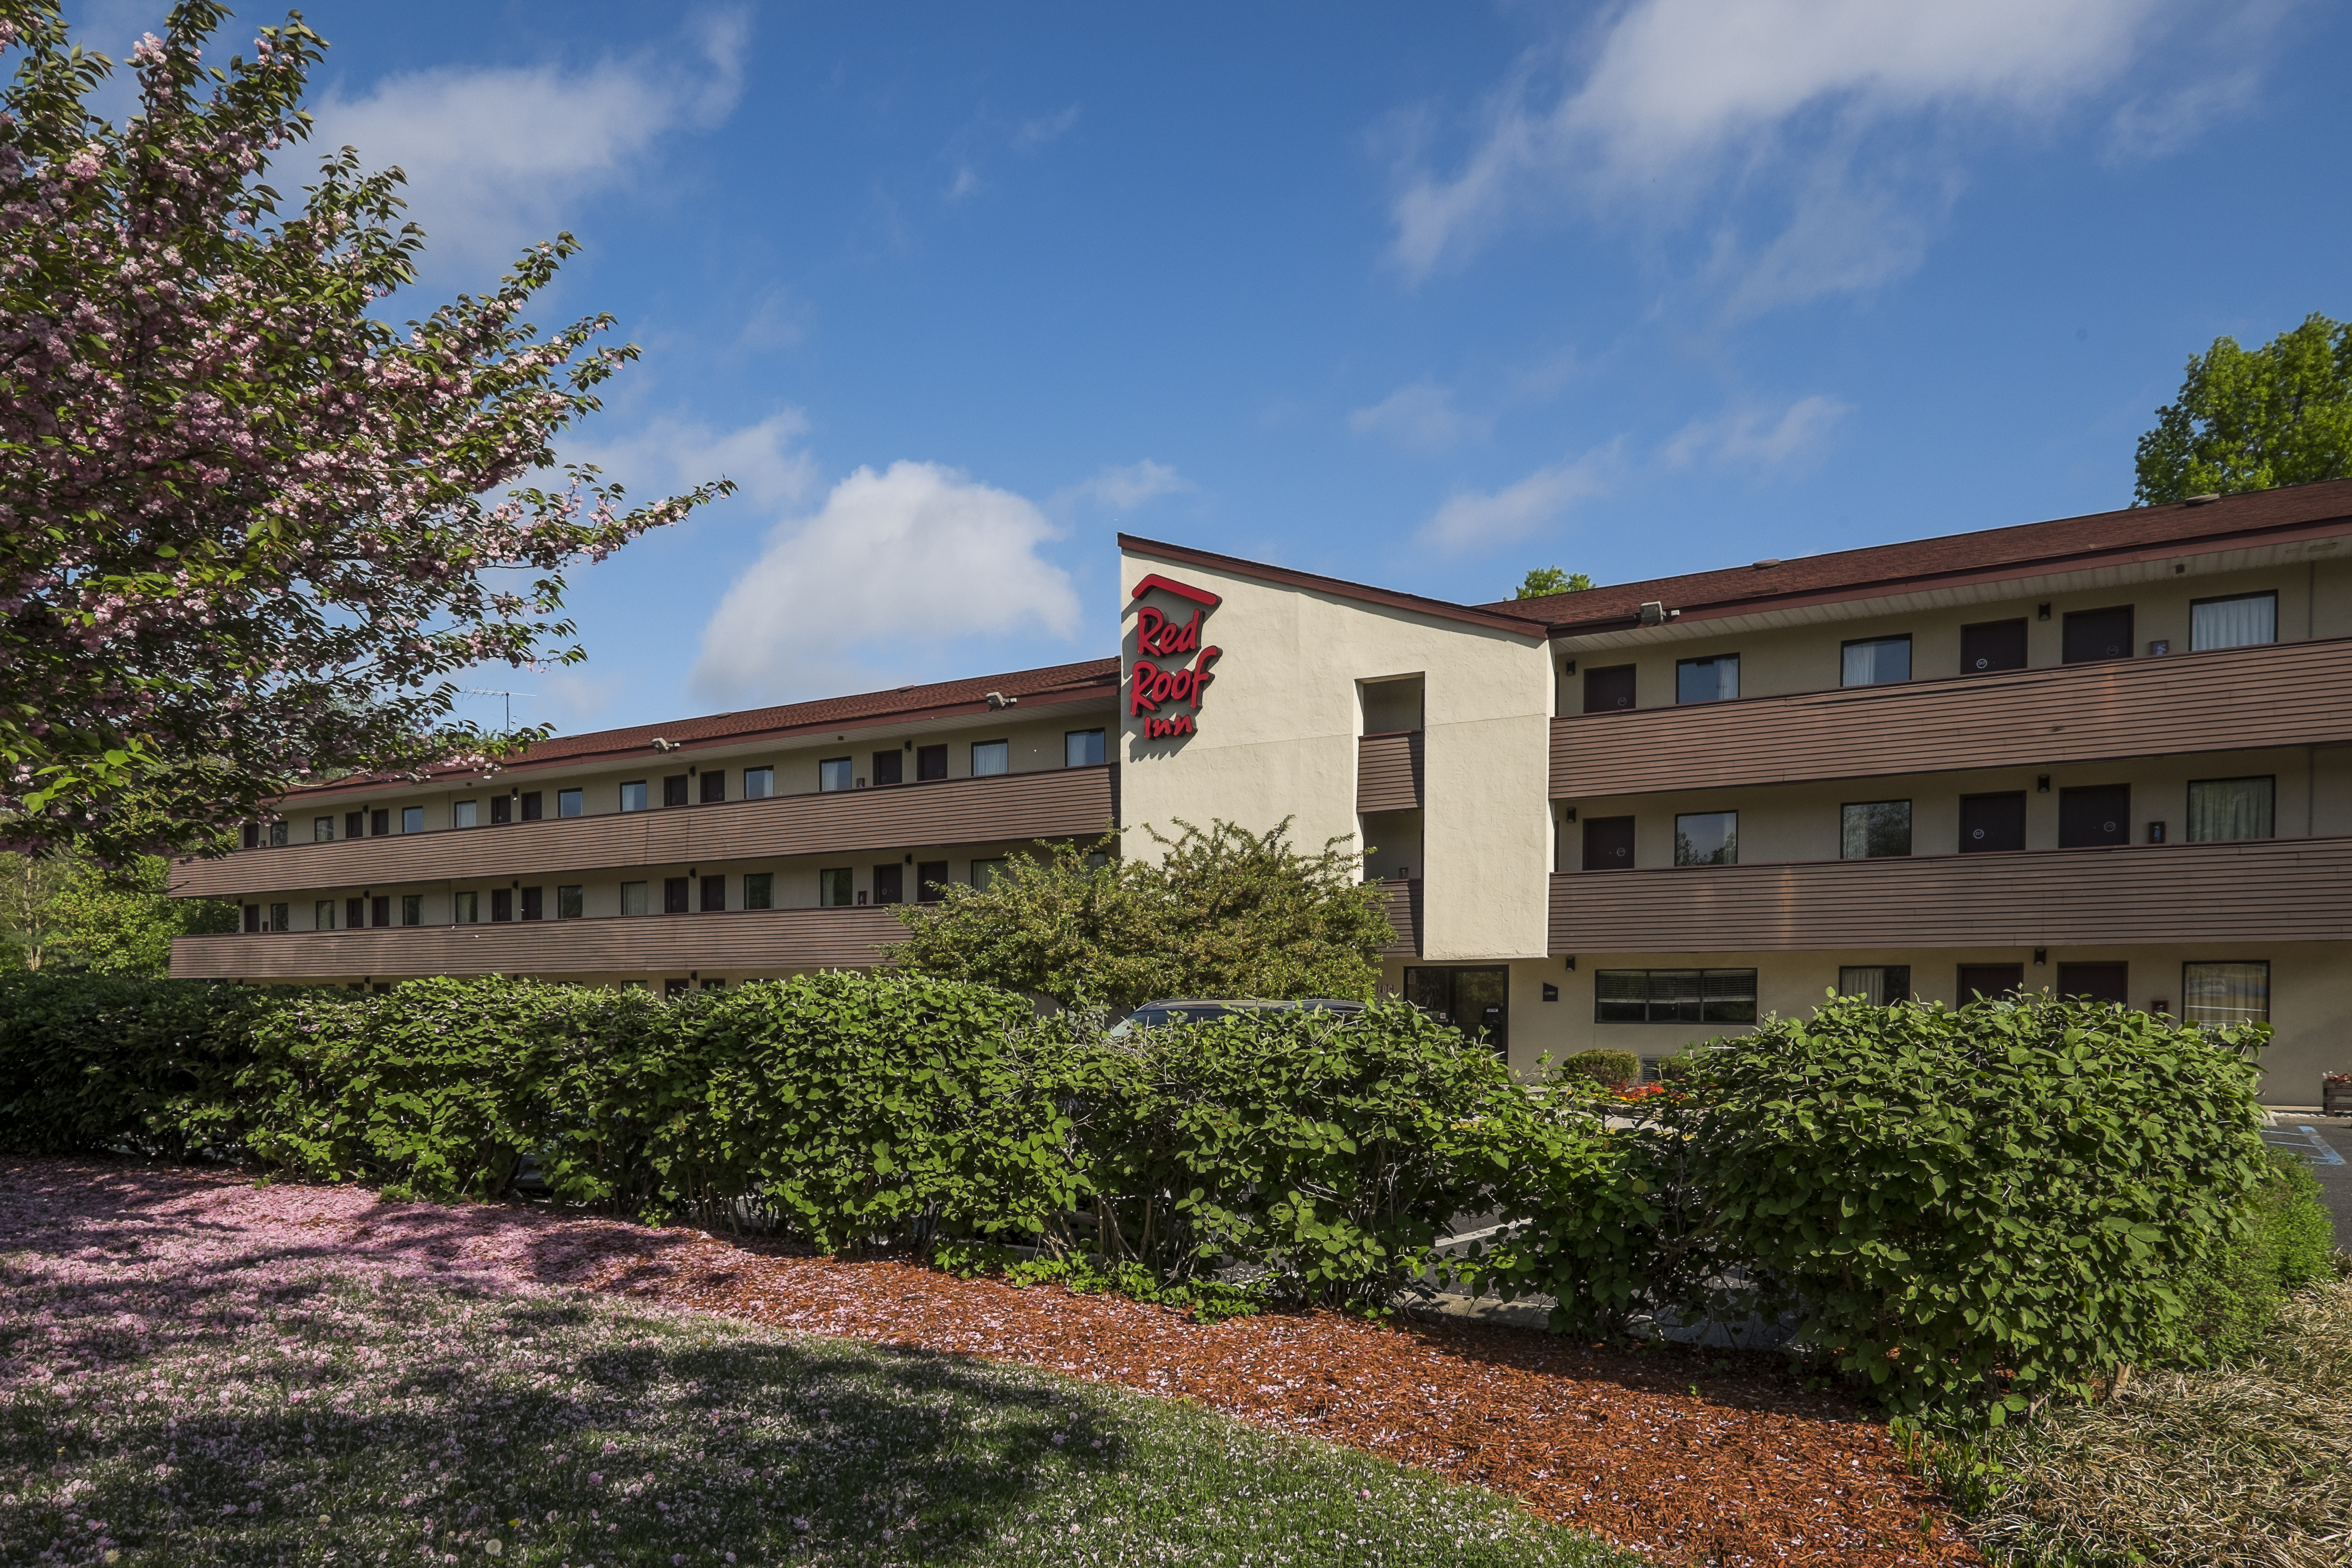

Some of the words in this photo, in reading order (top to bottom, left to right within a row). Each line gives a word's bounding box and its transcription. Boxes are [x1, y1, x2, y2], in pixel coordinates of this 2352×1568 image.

[1138, 607, 1201, 657] Red
[1130, 645, 1218, 717] Roof
[1144, 714, 1194, 739] Inn
[1378, 985, 1393, 993] FDC
